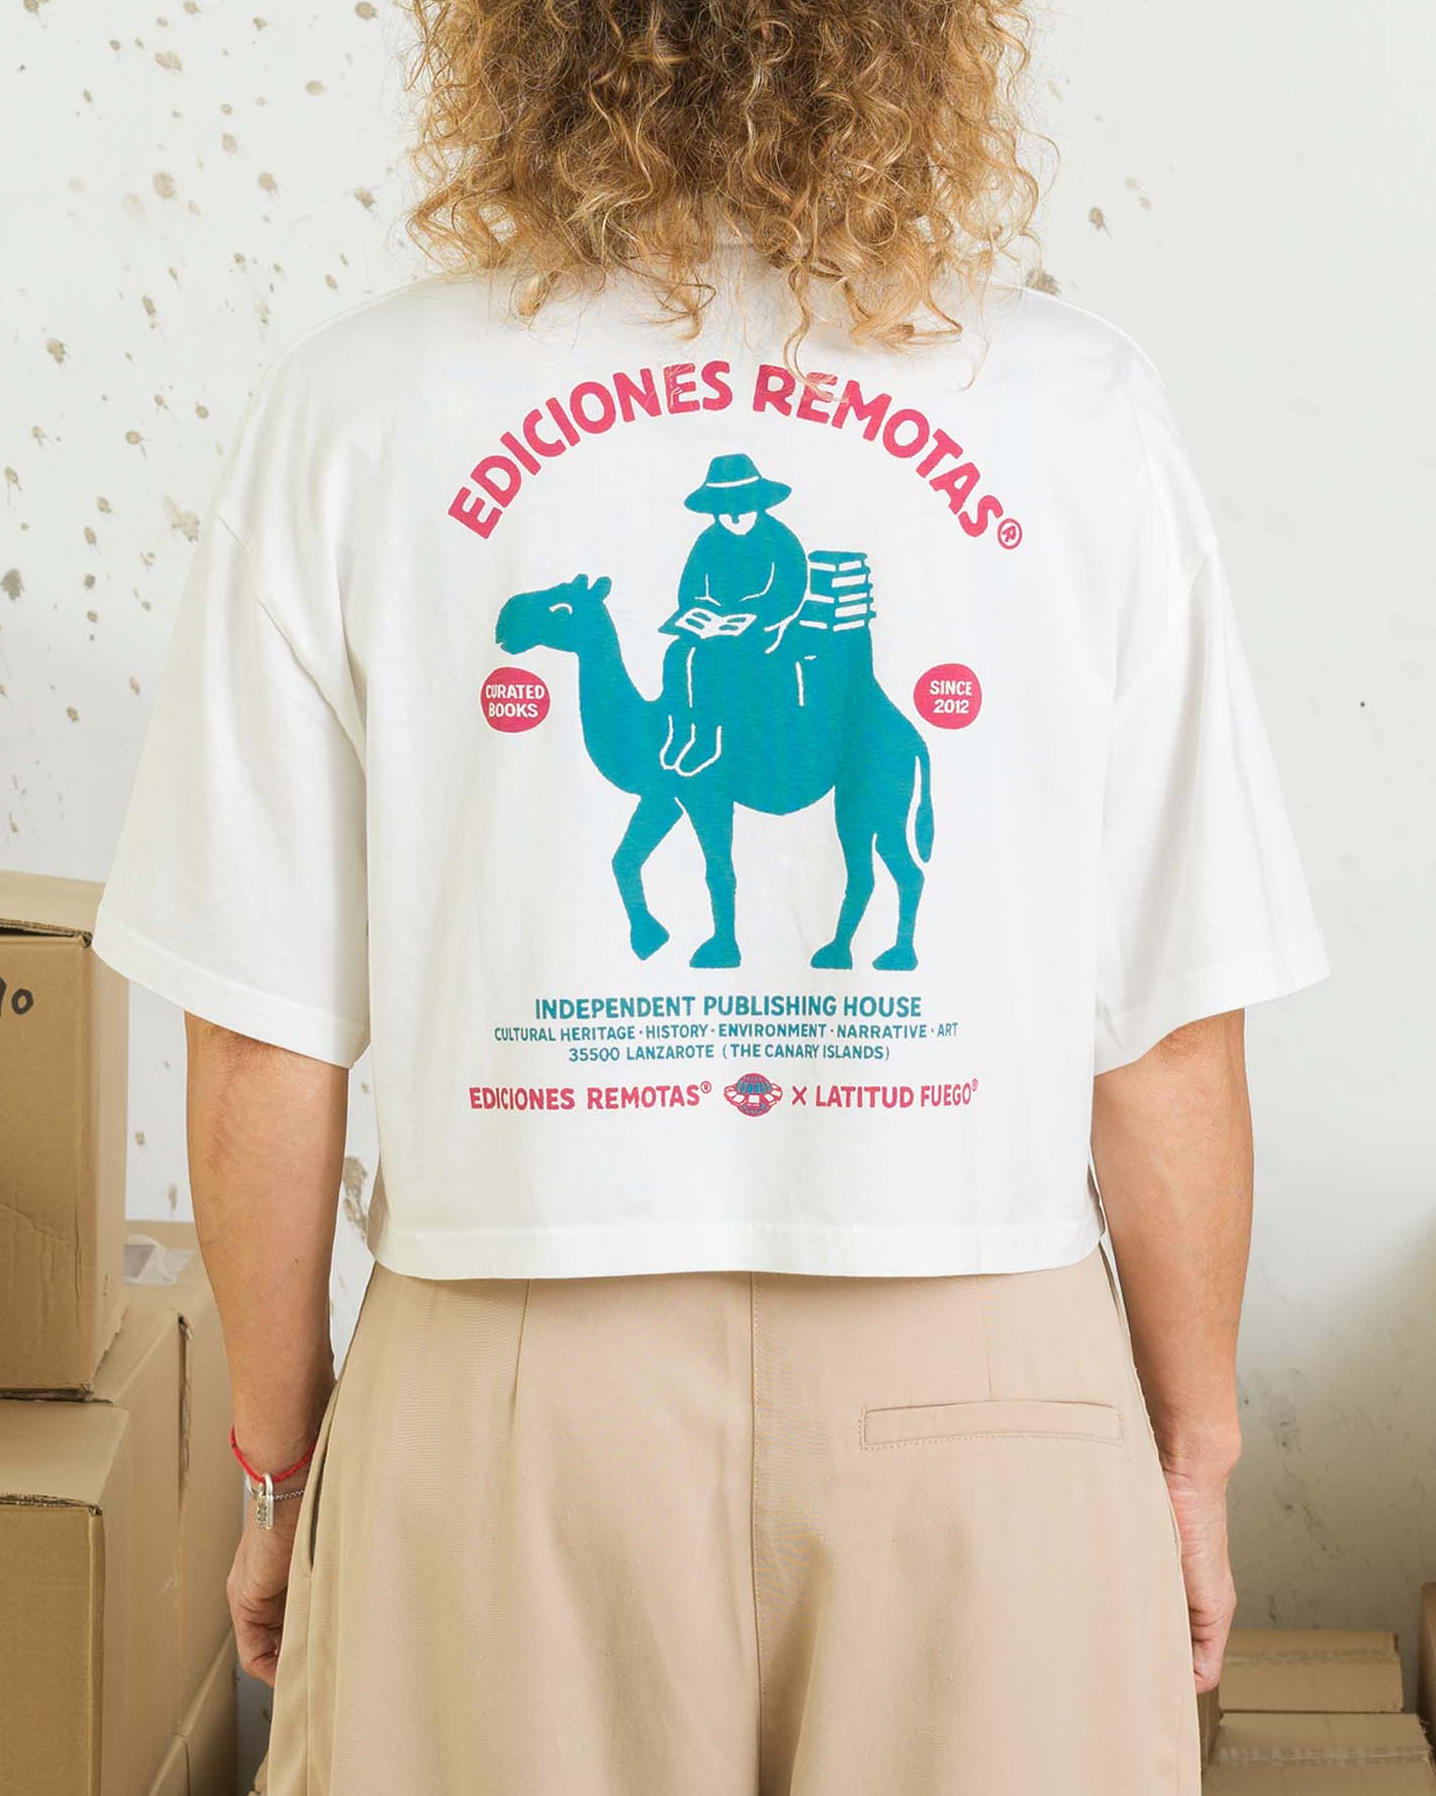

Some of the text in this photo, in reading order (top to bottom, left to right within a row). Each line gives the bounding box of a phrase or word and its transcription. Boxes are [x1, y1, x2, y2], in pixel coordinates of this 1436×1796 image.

[447, 359, 734, 540] EDICIONES
[485, 683, 546, 701] CURATED
[929, 680, 972, 696] SINCE
[488, 702, 539, 718] BOOKS
[933, 699, 969, 714] 2012
[535, 994, 921, 1021] INDEPENDENT PUBLISHING HOUSE
[494, 1022, 959, 1042] CULTURAL HERITAGE HISTORY ENVIRONMENT NARRATIVE ART
[568, 1047, 620, 1062] 35500
[626, 1044, 714, 1061] LANZAROTE
[764, 1044, 819, 1059] CANARY
[823, 1045, 890, 1061] ISLANDS)
[468, 1086, 576, 1112] EDICIONES
[814, 1084, 915, 1109] LATITUD
